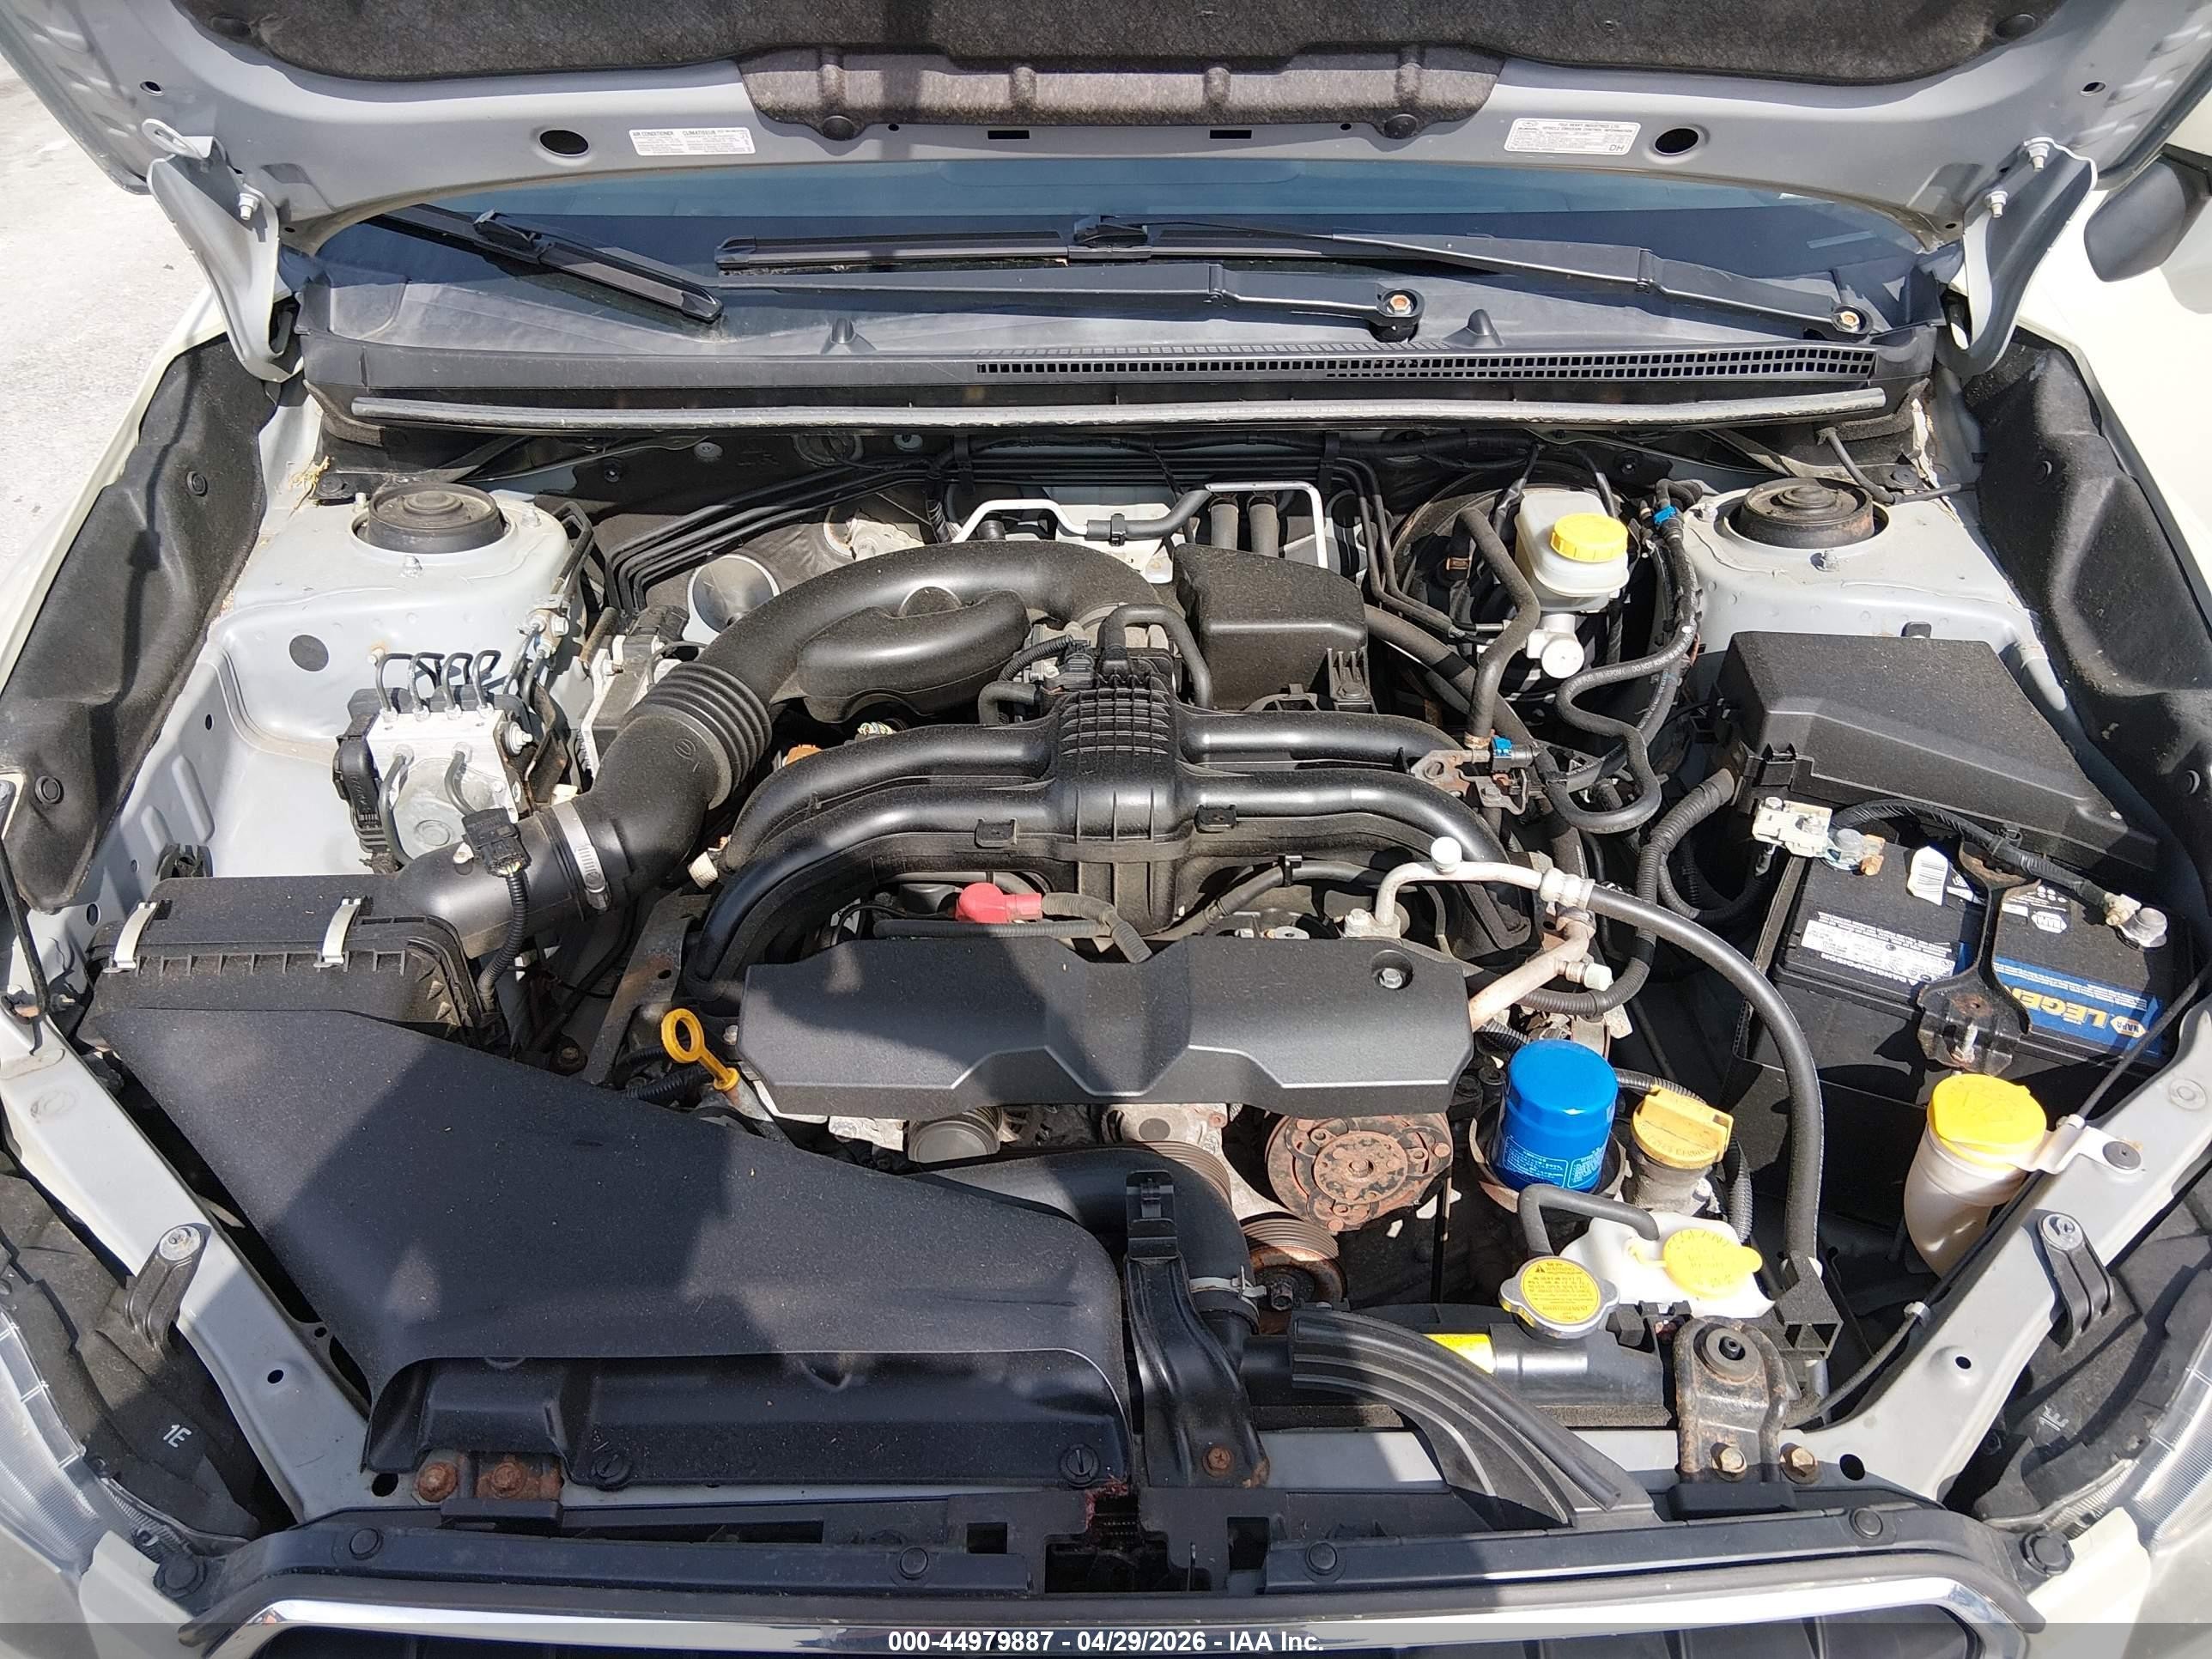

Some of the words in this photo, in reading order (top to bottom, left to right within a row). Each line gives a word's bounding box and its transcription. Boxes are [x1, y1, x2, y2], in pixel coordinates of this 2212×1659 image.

[1608, 143, 1625, 153] DH
[1632, 665, 1641, 673] DO
[1641, 661, 1653, 672] NOT
[162, 1424, 192, 1448] 1E
